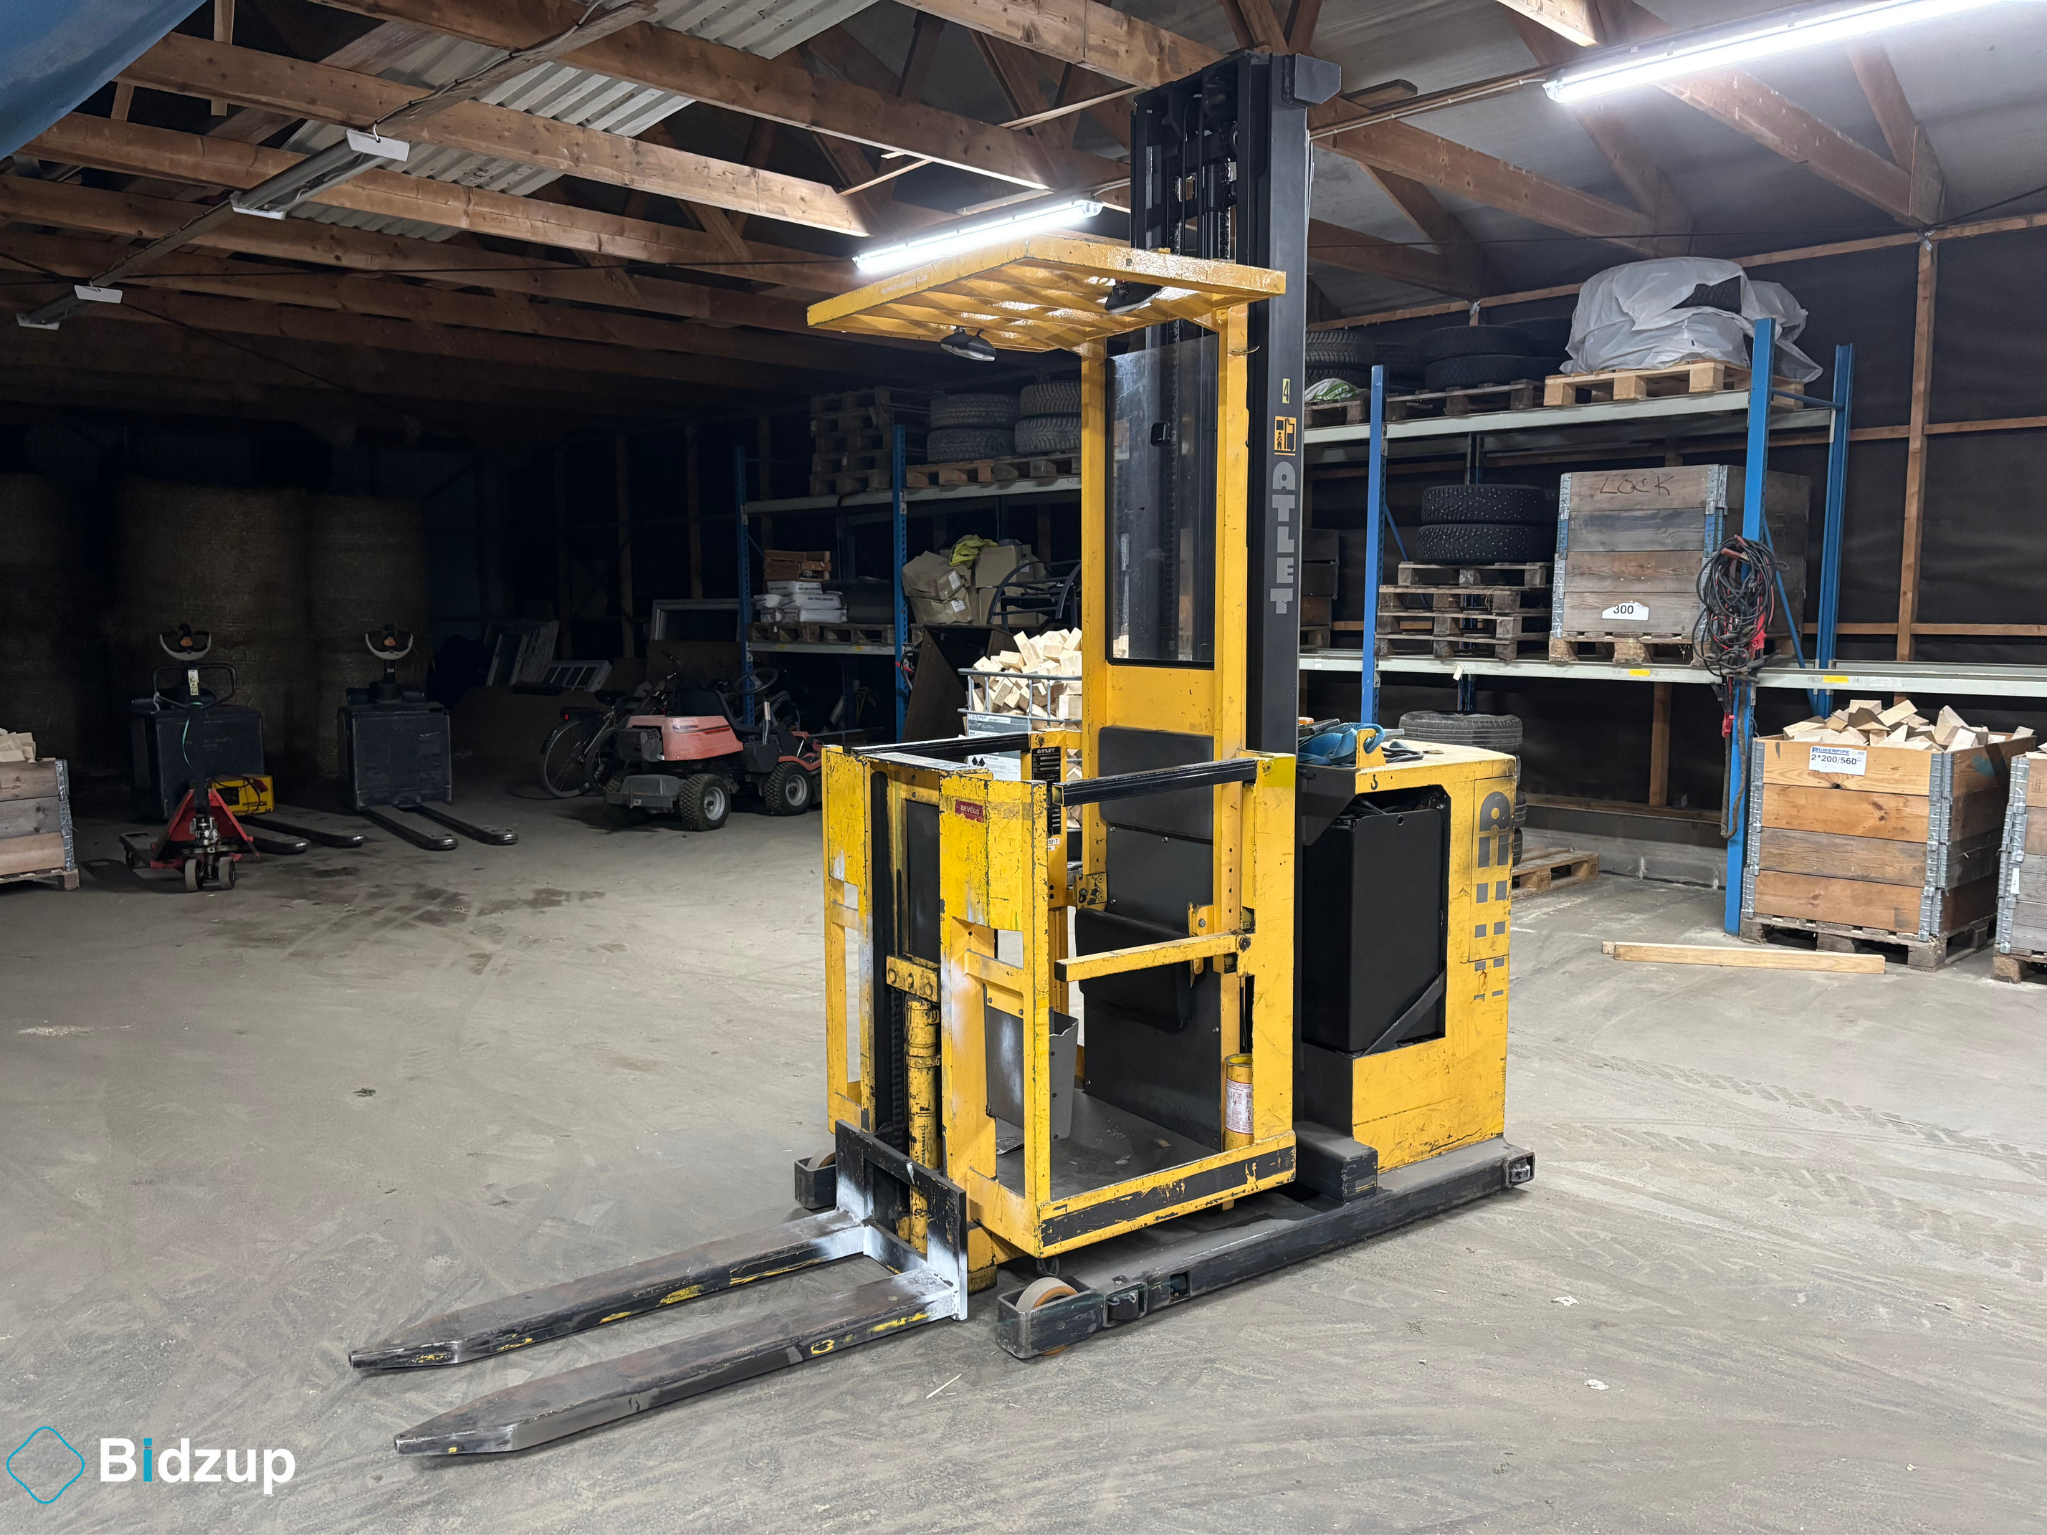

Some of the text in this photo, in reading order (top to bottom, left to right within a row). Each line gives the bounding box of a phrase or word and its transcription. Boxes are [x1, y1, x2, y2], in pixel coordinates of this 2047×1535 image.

[1600, 475, 1674, 496] LOCK
[1270, 461, 1296, 614] ATLET
[1613, 605, 1634, 615] 300
